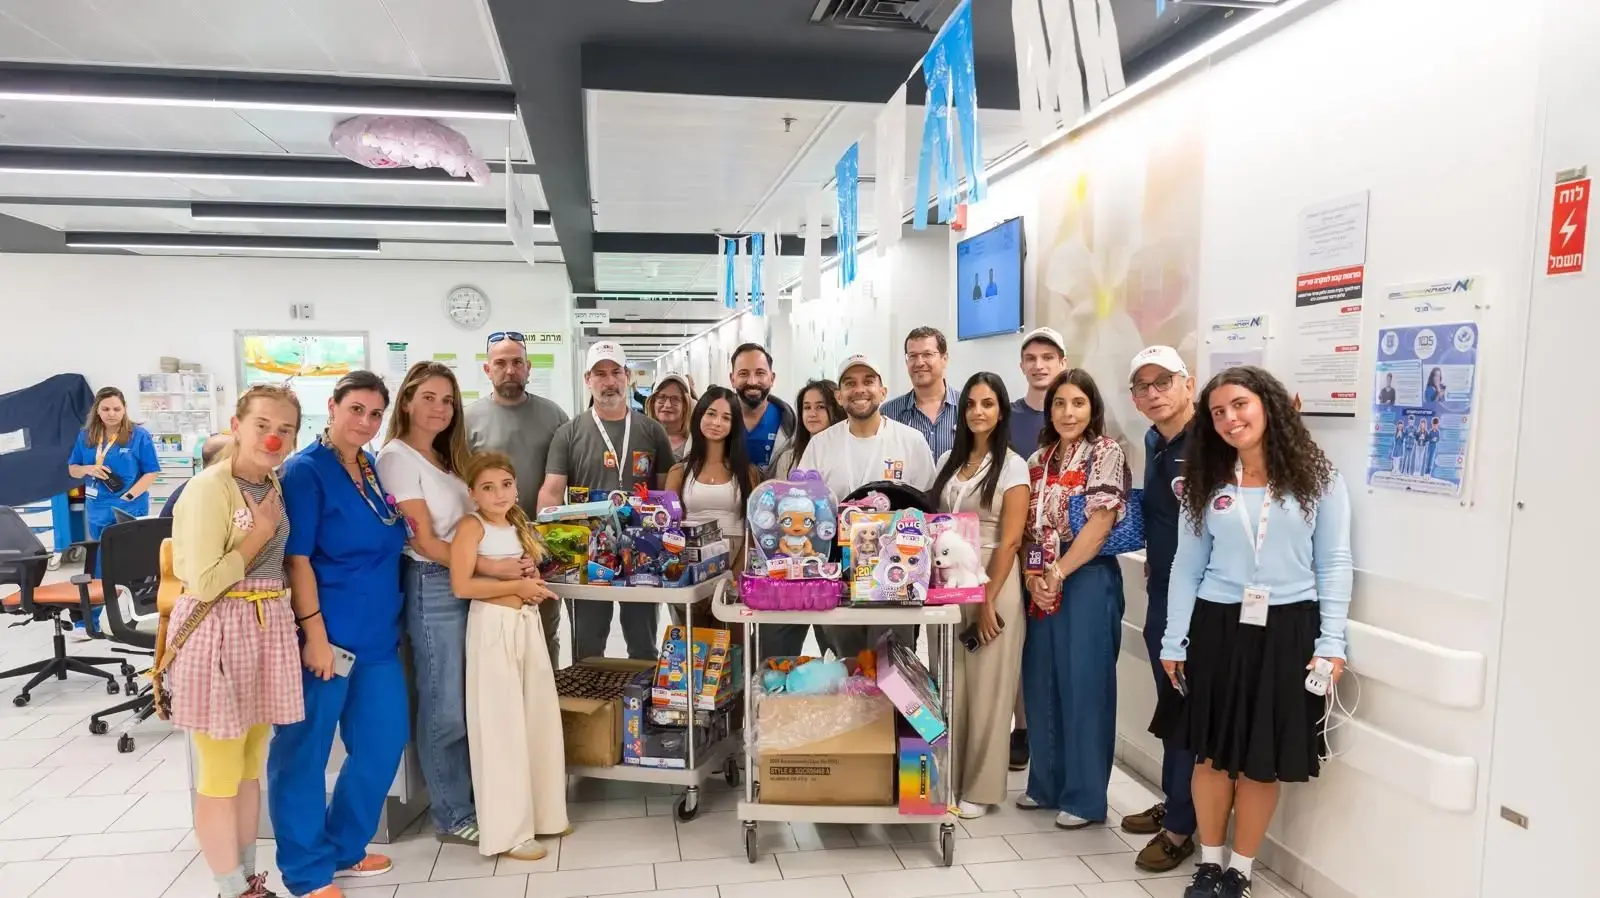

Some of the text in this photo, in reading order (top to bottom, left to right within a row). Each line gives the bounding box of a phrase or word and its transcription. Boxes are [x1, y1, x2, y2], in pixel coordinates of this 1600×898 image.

[1560, 185, 1584, 204] לוח
[1550, 253, 1582, 268] חשמל
[524, 333, 561, 341] מרחב מוג
[1418, 335, 1434, 346] 105
[770, 767, 789, 775] STYLE
